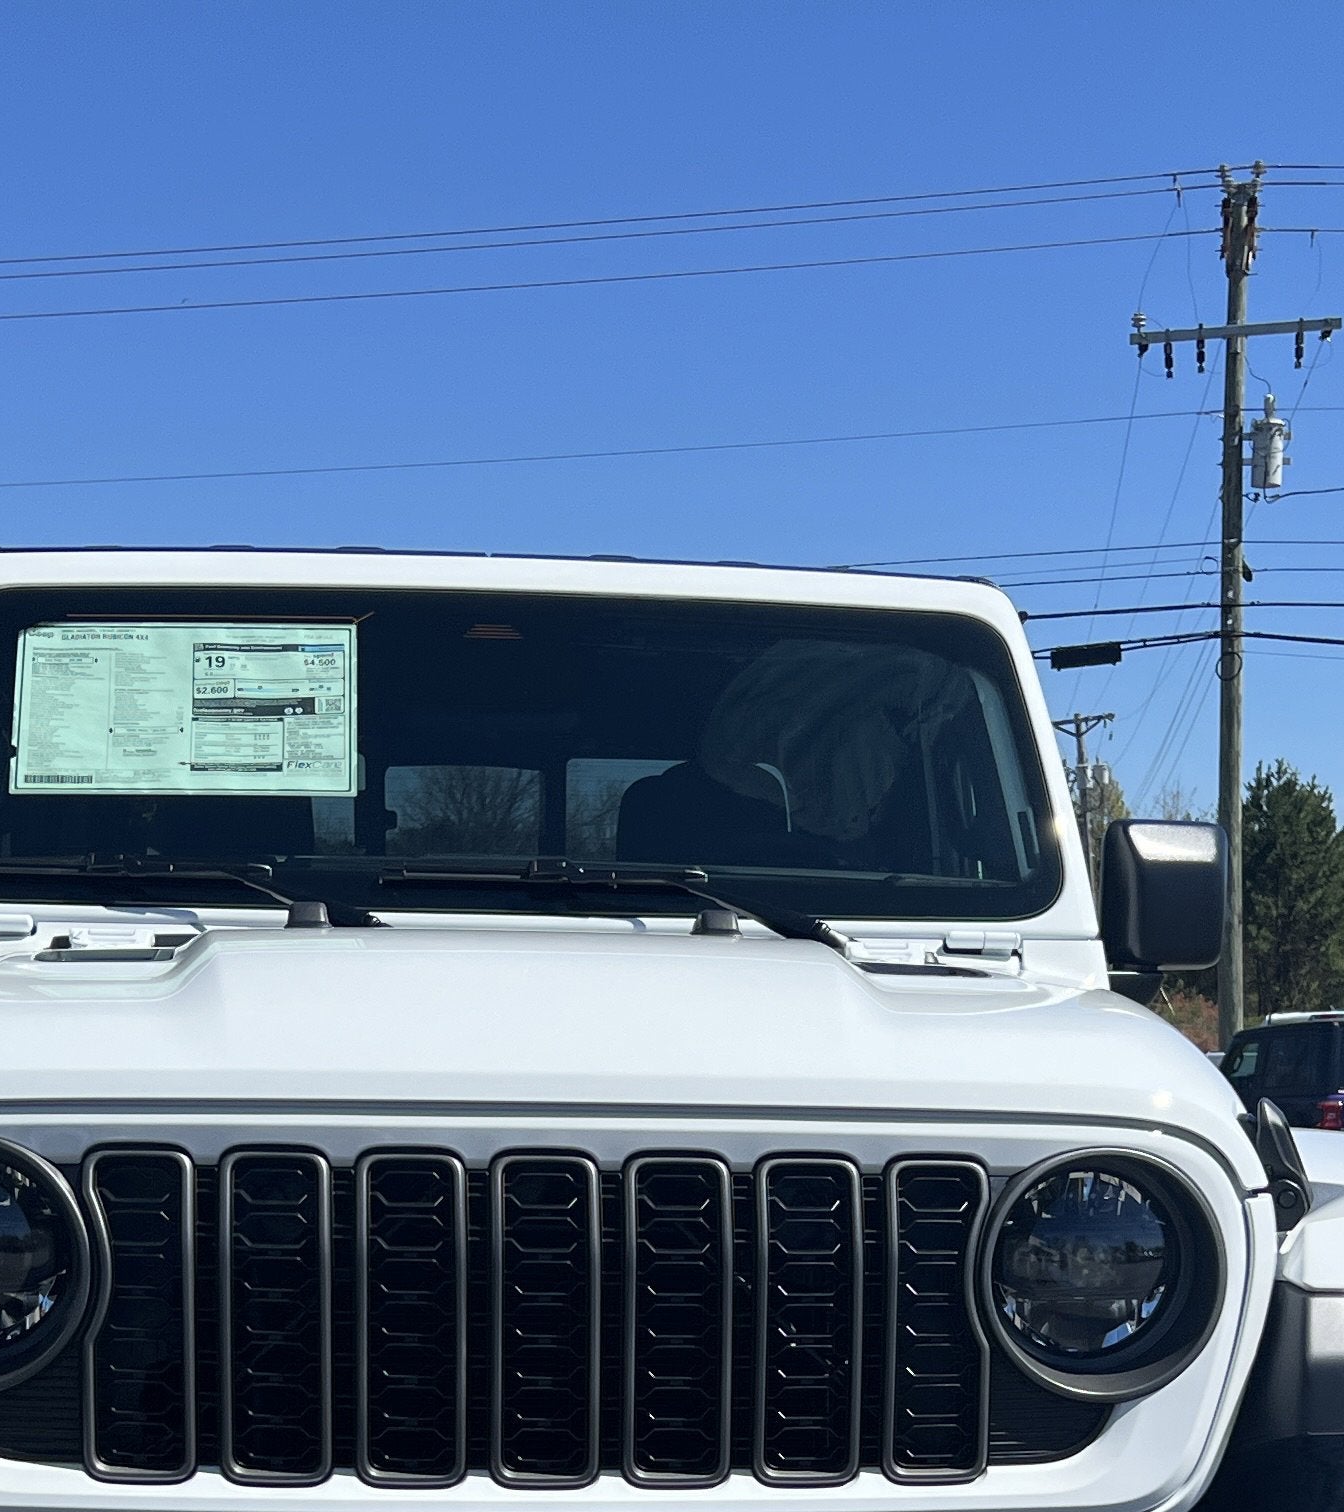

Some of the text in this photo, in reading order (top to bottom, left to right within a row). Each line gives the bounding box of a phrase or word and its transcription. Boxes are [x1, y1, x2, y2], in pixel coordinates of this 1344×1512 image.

[61, 633, 101, 641] GLADIATOR
[102, 633, 134, 641] RUBICON
[205, 655, 226, 669] 19
[287, 760, 342, 769] FlexCare
